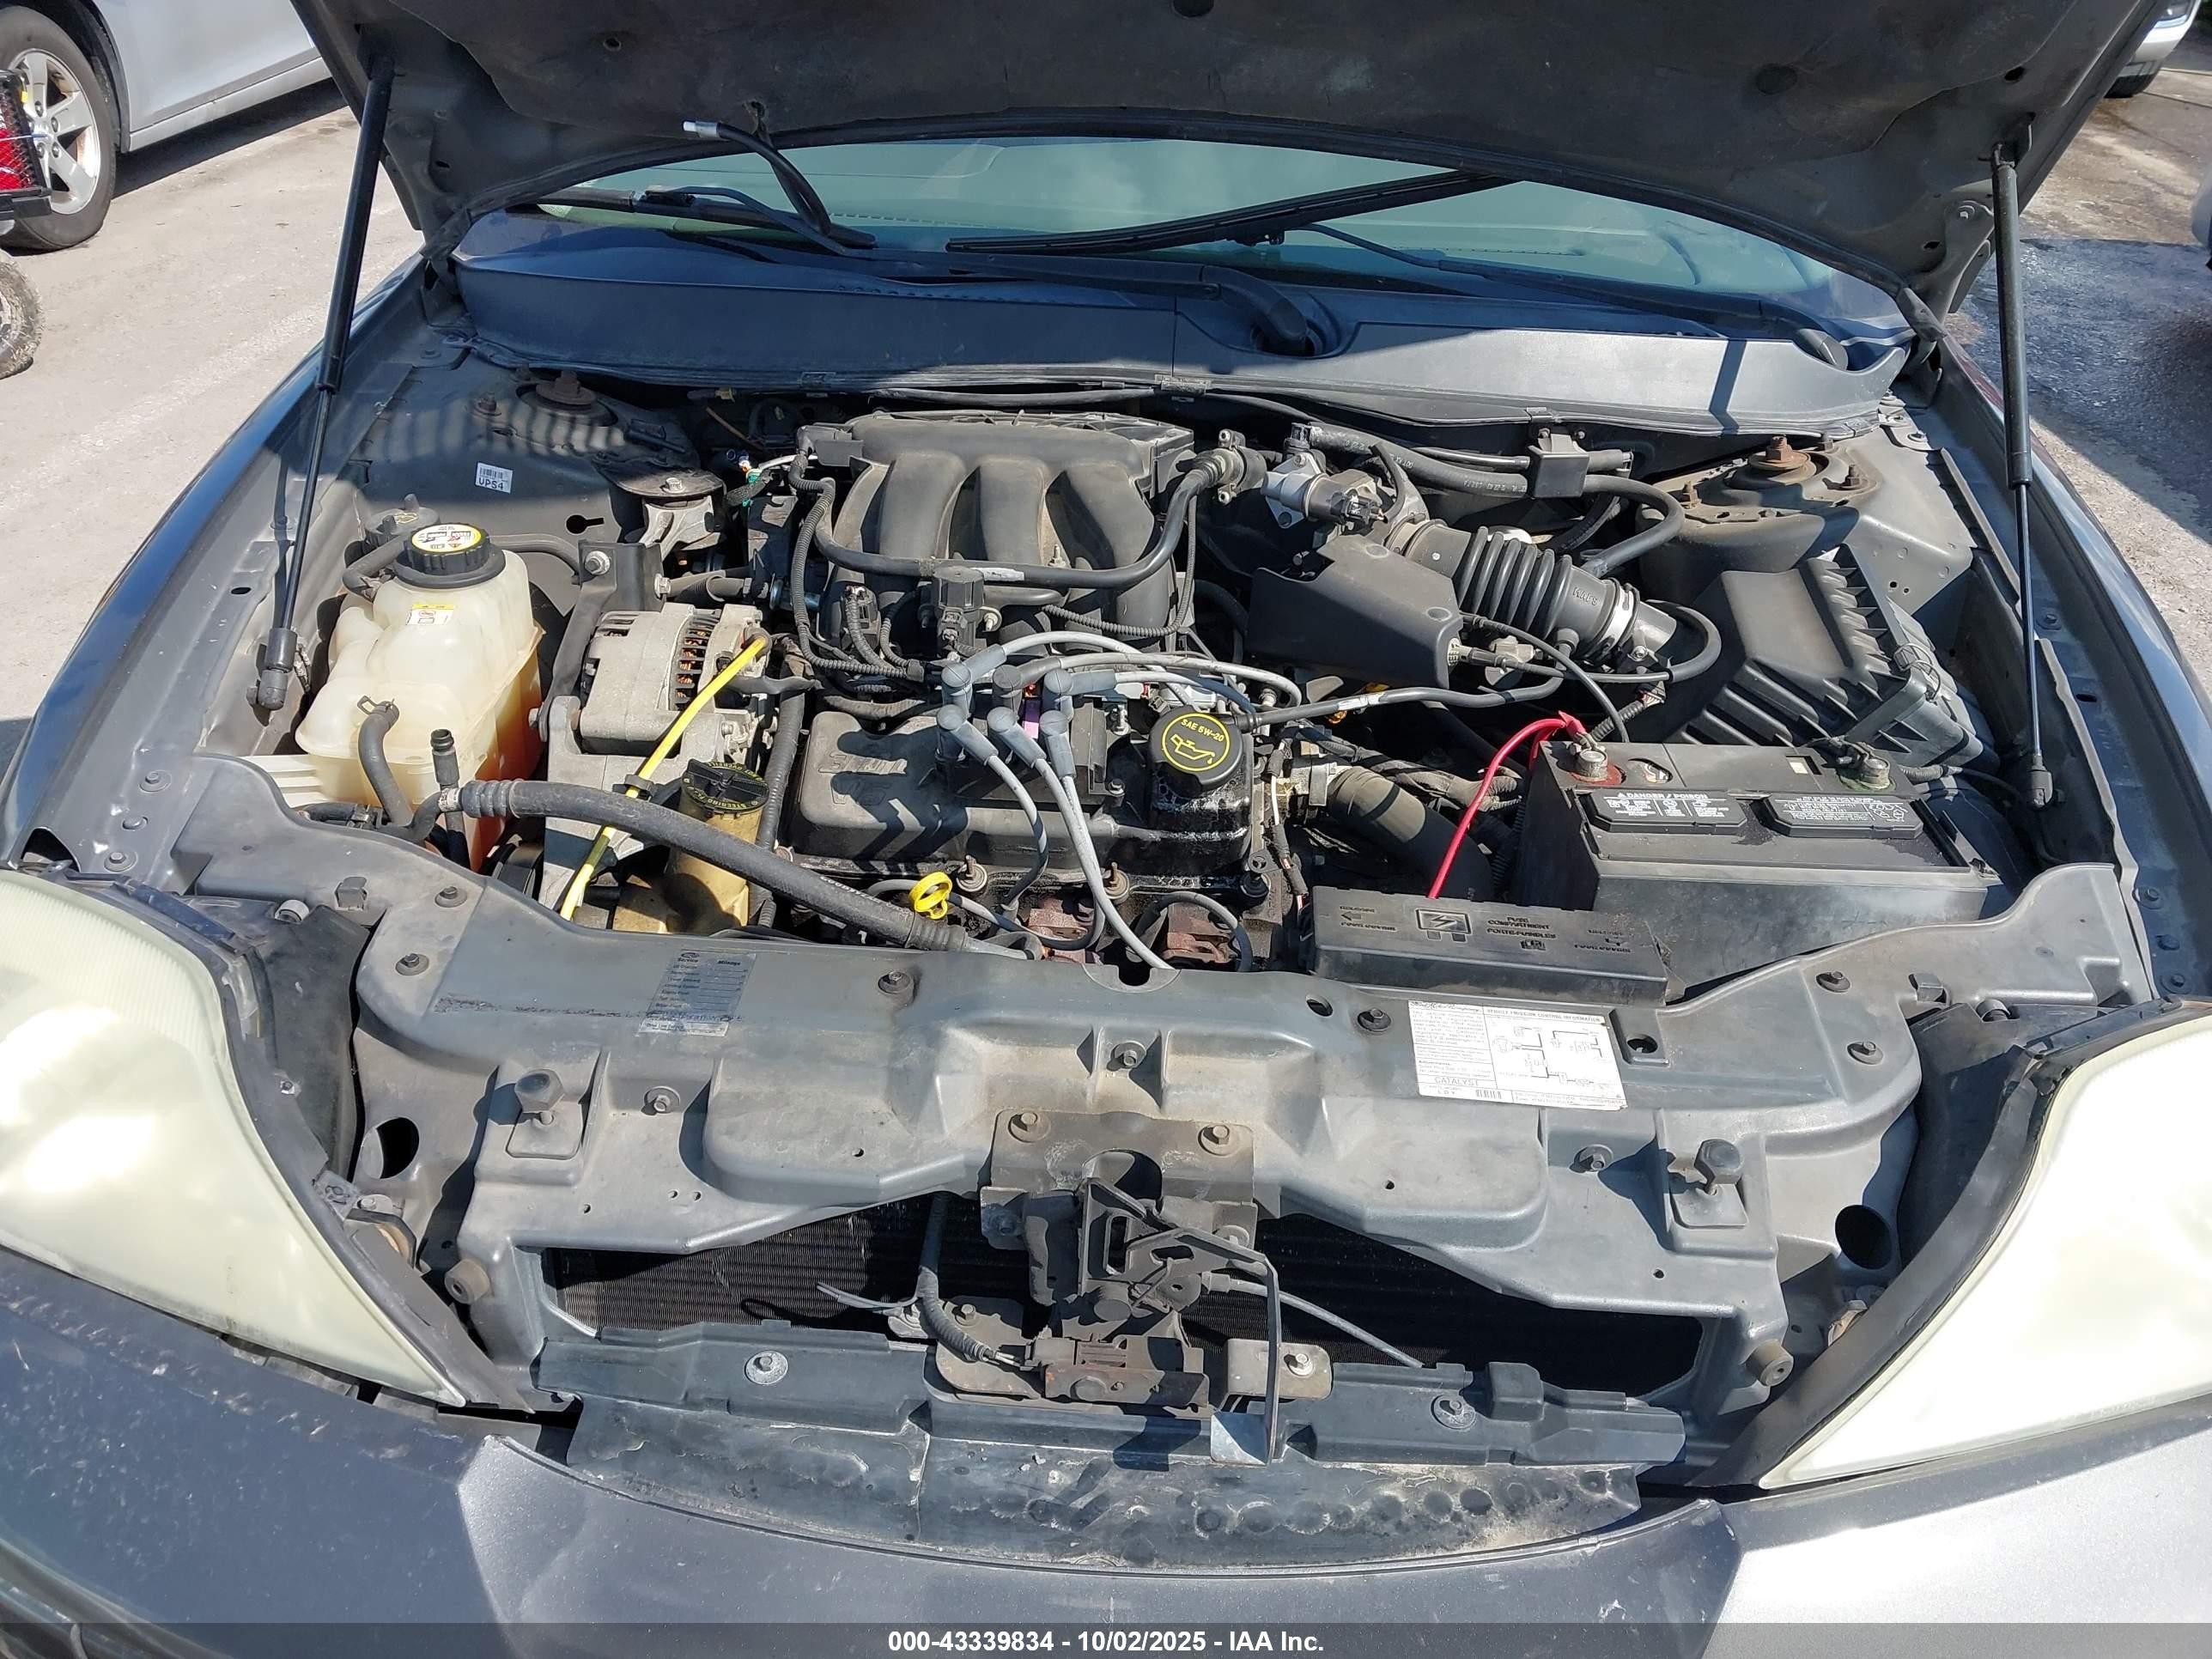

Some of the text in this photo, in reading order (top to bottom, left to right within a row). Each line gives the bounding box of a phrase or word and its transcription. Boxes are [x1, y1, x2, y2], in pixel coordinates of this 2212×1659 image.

[1181, 719, 1225, 742] SAE 5W-20
[706, 798, 747, 810] STEERING
[1487, 919, 1550, 930] COMPARTMENT
[1563, 1014, 1602, 1023] INFORMATION
[1434, 1076, 1479, 1086] CATALYST
